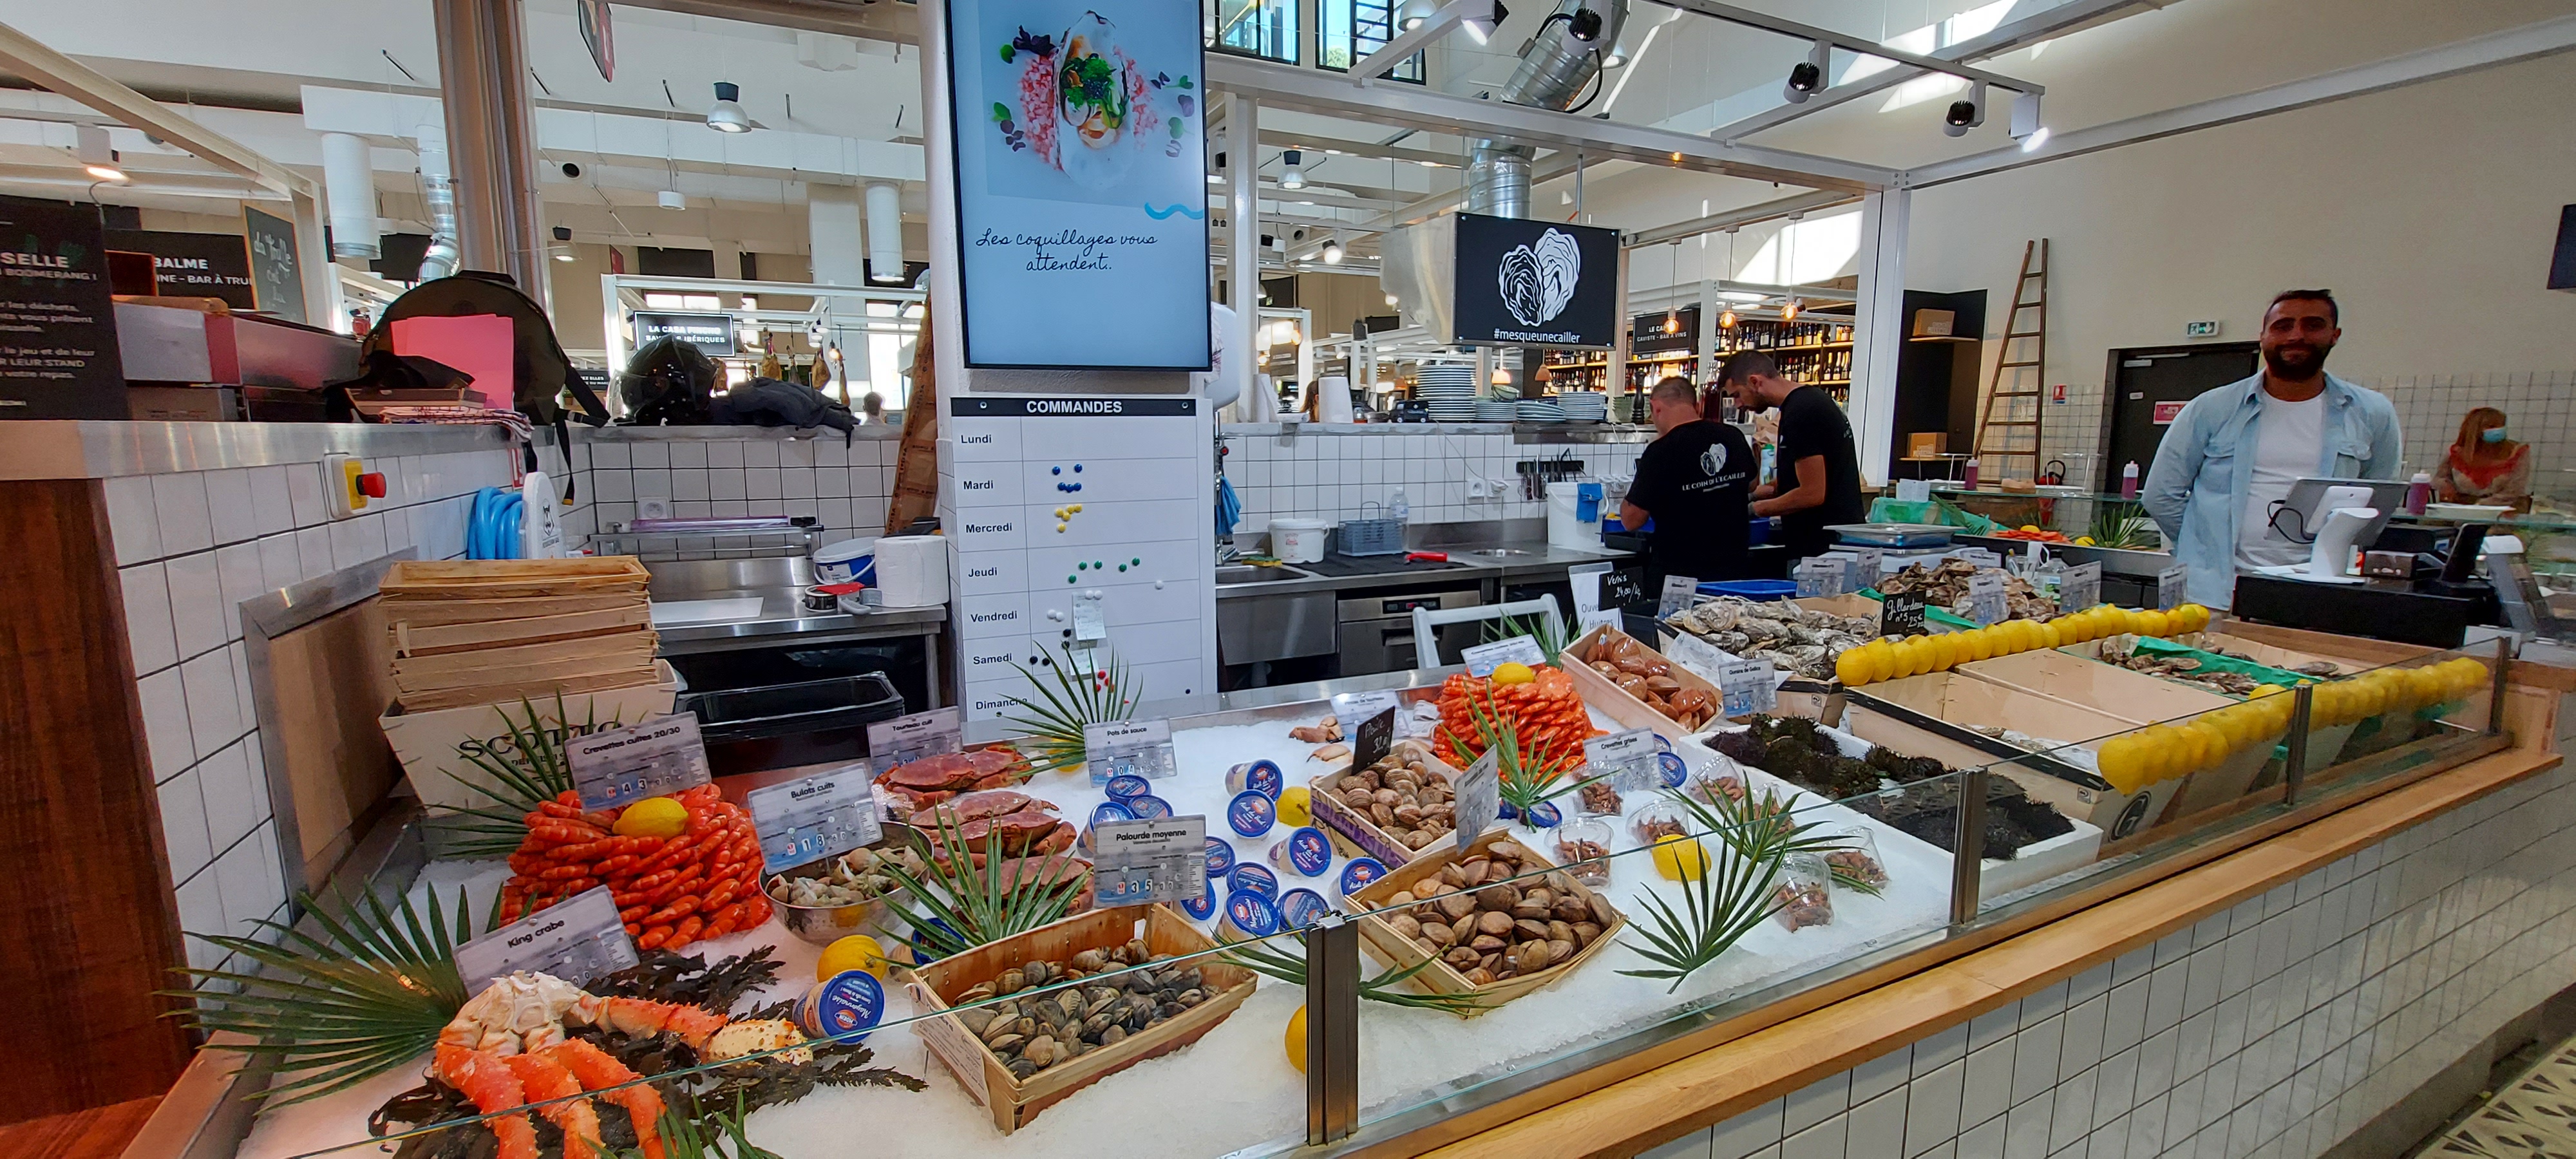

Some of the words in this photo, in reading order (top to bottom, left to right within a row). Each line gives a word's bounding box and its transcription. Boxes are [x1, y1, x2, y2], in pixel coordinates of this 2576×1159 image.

[976, 229, 1012, 247] Les
[1016, 230, 1117, 257] coquillages
[1121, 236, 1158, 246] vous
[188, 276, 212, 284] BAR
[683, 334, 725, 344] IBÉRIQUES
[1494, 328, 1580, 343] #mesqueunecailler
[11, 358, 42, 366] LEUR
[44, 359, 85, 367] STAND
[1027, 400, 1122, 414] COMMANDES
[961, 434, 992, 444] Lundi
[963, 480, 994, 490] Mardi
[1692, 480, 1708, 489] COIN
[965, 522, 1012, 534] Mercredi
[968, 567, 998, 578] Jeudi
[971, 610, 1018, 623] Vendredi
[973, 652, 1012, 666] Samedi
[583, 739, 625, 755] Crevettes
[654, 726, 680, 738] 20/30
[1601, 740, 1622, 749] Crevettes
[791, 787, 815, 798] Bulots
[817, 782, 835, 791] cuits
[1117, 831, 1150, 841] Palourde
[1152, 829, 1187, 839] moyenne
[507, 934, 533, 948] King
[535, 919, 565, 936] crabe
[832, 995, 871, 1019] Mayonnaise
